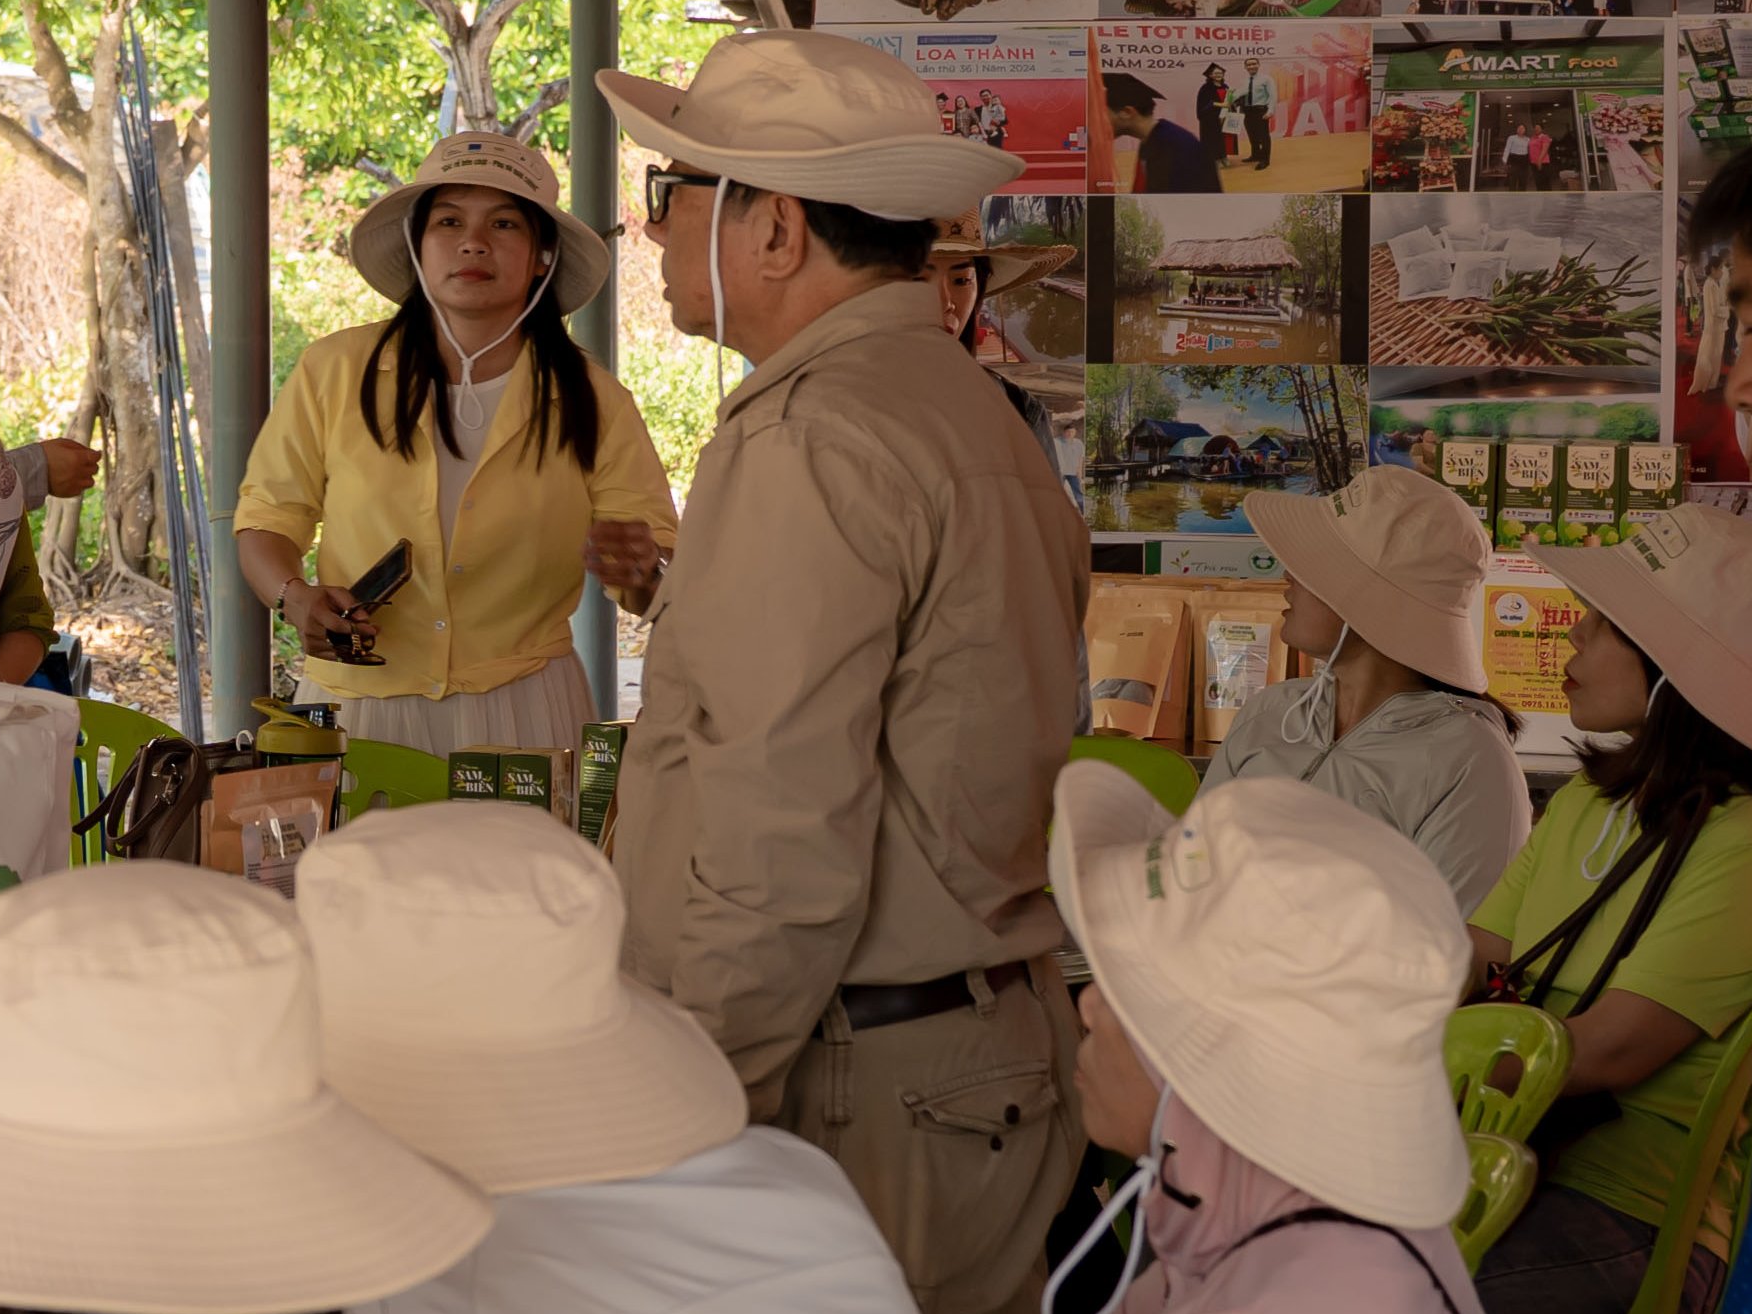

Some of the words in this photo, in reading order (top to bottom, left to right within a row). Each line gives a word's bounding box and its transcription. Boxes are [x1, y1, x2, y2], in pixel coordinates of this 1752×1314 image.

[916, 48, 956, 61] LOA
[965, 44, 1035, 61] THÀNH
[1117, 44, 1164, 55] TRAO
[1101, 57, 1142, 68] NĂM
[1147, 59, 1185, 68] 2024
[960, 65, 973, 73] 36
[982, 64, 1007, 73] Năm
[1010, 64, 1036, 73] 2024
[1450, 456, 1474, 467] SAM
[1513, 457, 1538, 468] SAM
[1575, 460, 1600, 470] SAM
[1636, 461, 1661, 471] SAM
[588, 740, 609, 752] SAM
[456, 770, 484, 782] SAM
[507, 772, 533, 784] SAM
